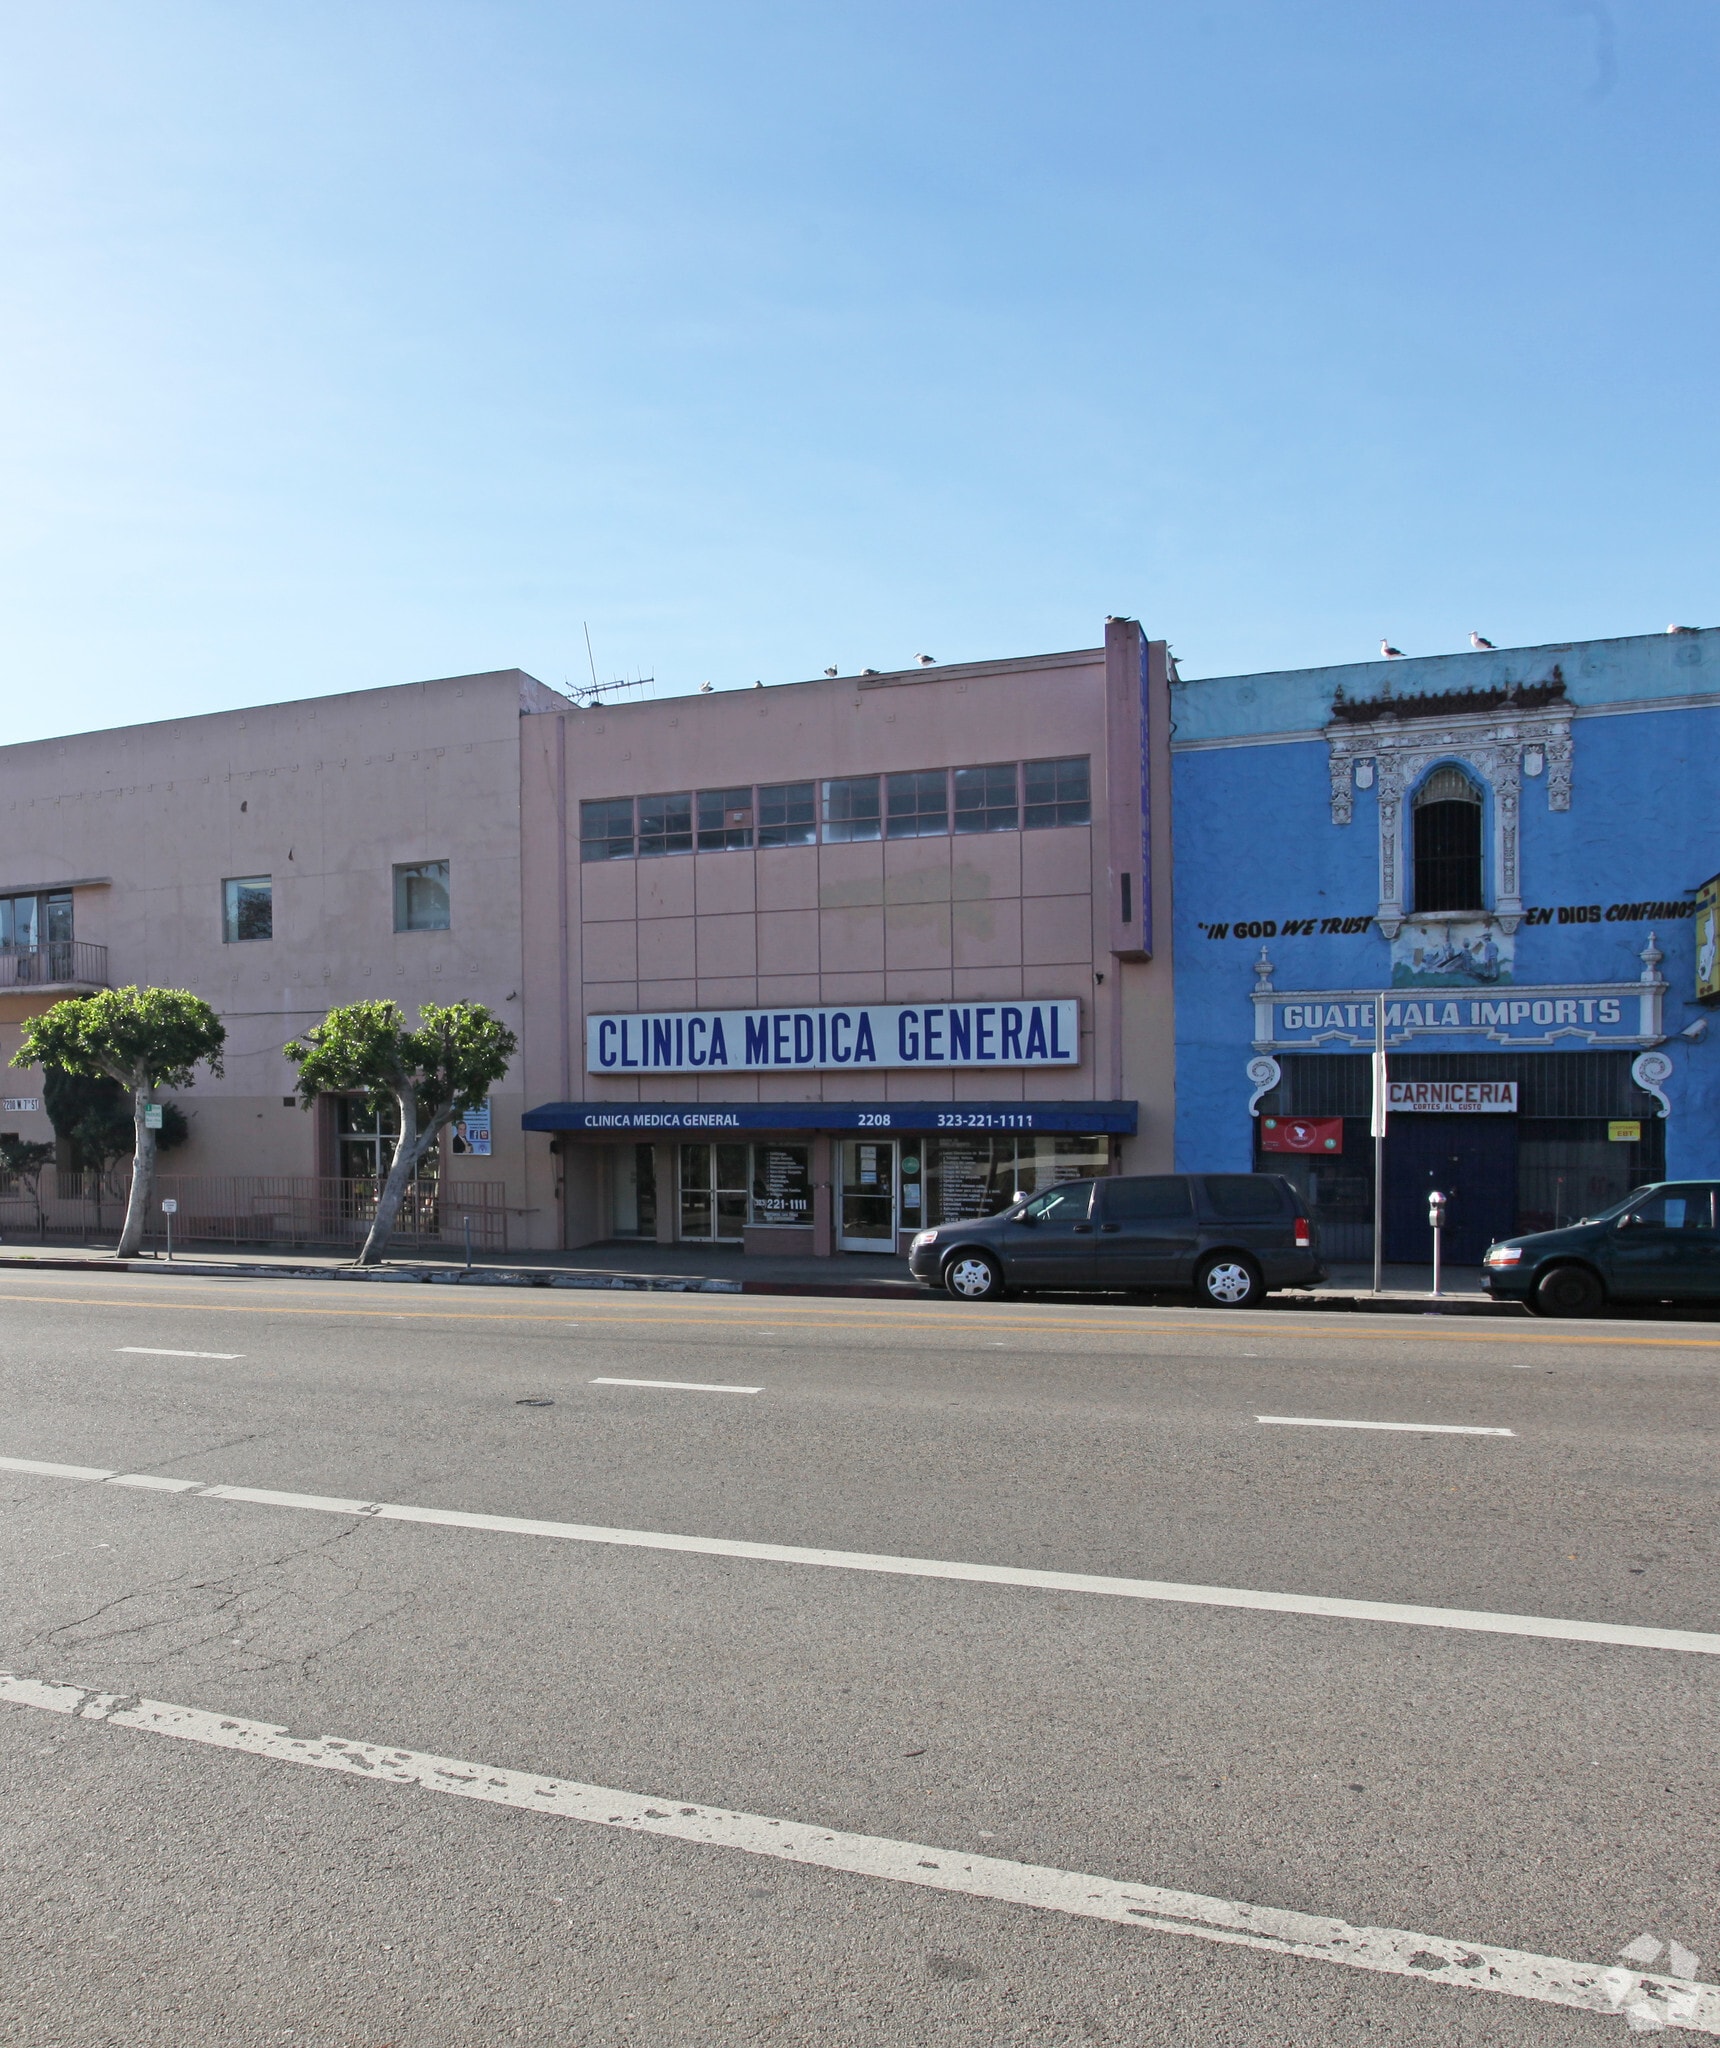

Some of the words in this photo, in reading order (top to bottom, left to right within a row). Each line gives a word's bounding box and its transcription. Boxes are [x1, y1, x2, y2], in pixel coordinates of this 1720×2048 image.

[1525, 907, 1554, 925] EN
[1557, 905, 1602, 924] DIOS
[1605, 901, 1697, 922] CONFIAMOS
[1233, 920, 1277, 939] GOD
[1281, 918, 1318, 936] WE
[1319, 916, 1375, 934] TRUST
[1283, 1003, 1460, 1029] GUATEMALA
[1470, 999, 1621, 1025] IMPORTS
[599, 1017, 728, 1067] CLINICA
[745, 1012, 877, 1064] MEDICA
[899, 1006, 1070, 1061] GENERAL
[1389, 1083, 1513, 1103] CARNICERIA
[584, 1115, 630, 1127] CLINICA
[633, 1114, 680, 1126] MEDICA
[682, 1114, 740, 1126] GENERAL
[857, 1114, 891, 1126] 2208
[937, 1114, 1032, 1127] 323-221-1111
